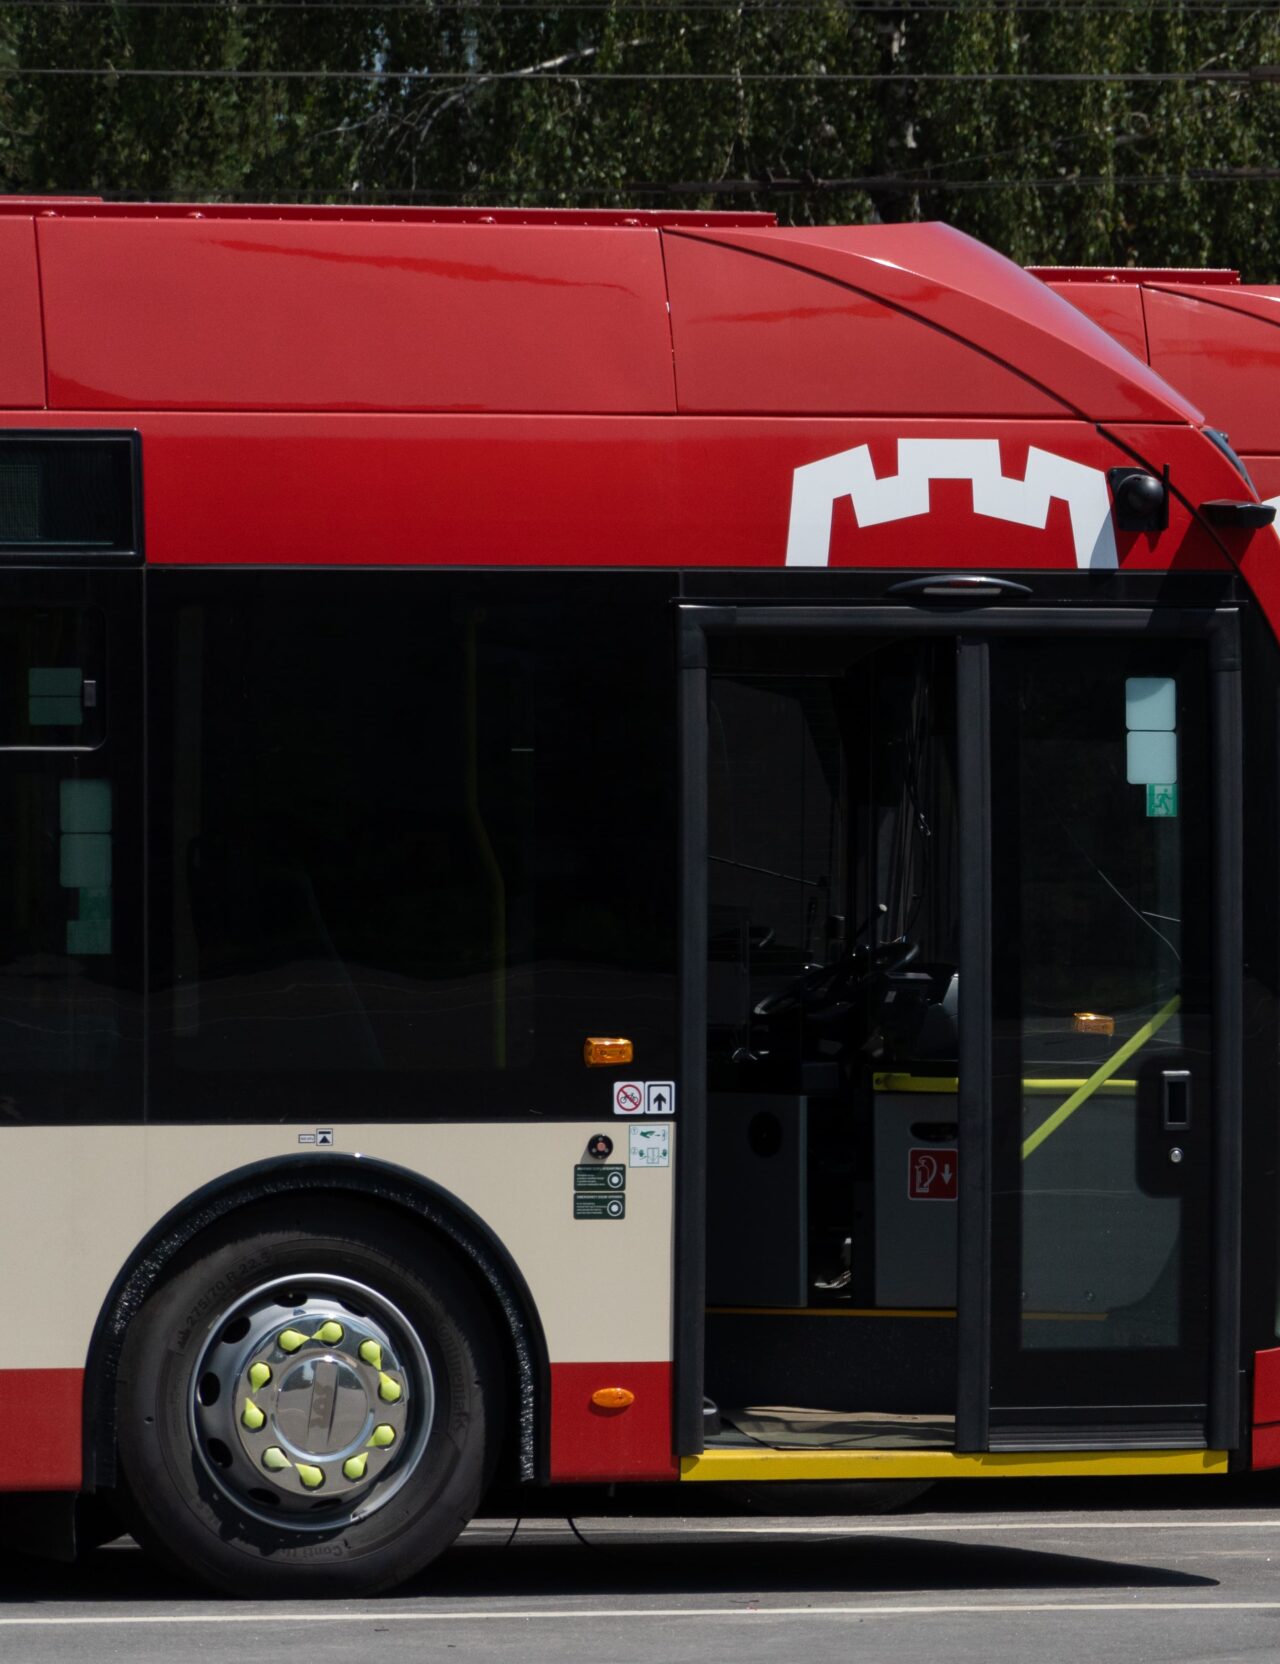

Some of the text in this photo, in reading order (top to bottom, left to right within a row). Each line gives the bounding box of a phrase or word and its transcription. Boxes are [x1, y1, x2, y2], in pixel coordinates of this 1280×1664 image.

[186, 1279, 225, 1326] 275/70
[238, 1251, 272, 1275] 22.5
[302, 1542, 343, 1558] Conti
